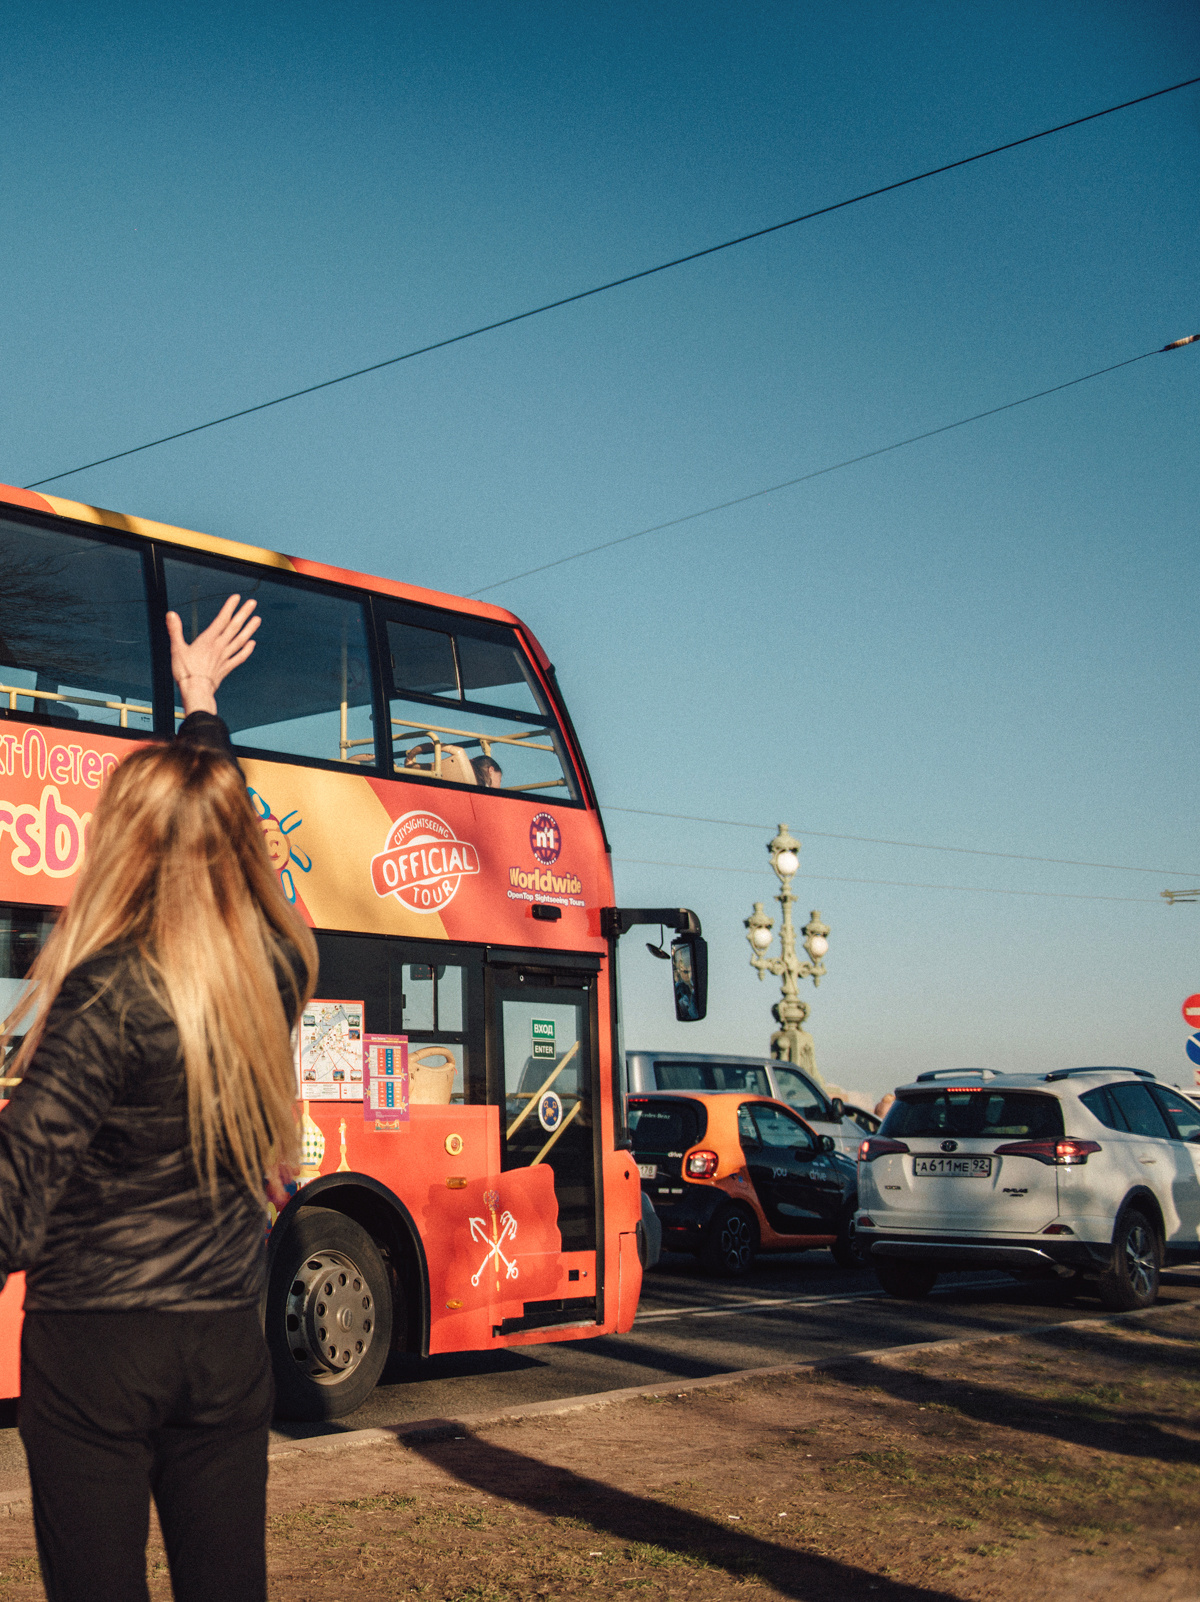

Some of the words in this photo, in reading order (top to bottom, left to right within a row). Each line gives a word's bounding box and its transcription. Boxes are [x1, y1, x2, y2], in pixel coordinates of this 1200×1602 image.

[394, 818, 449, 845] CITYSIGHTSEEING
[382, 847, 474, 887] OFFICIAL
[509, 867, 582, 894] Worldwide
[413, 879, 453, 906] TOUR
[533, 1023, 554, 1036] ВХОД
[534, 1045, 553, 1054] ENTER
